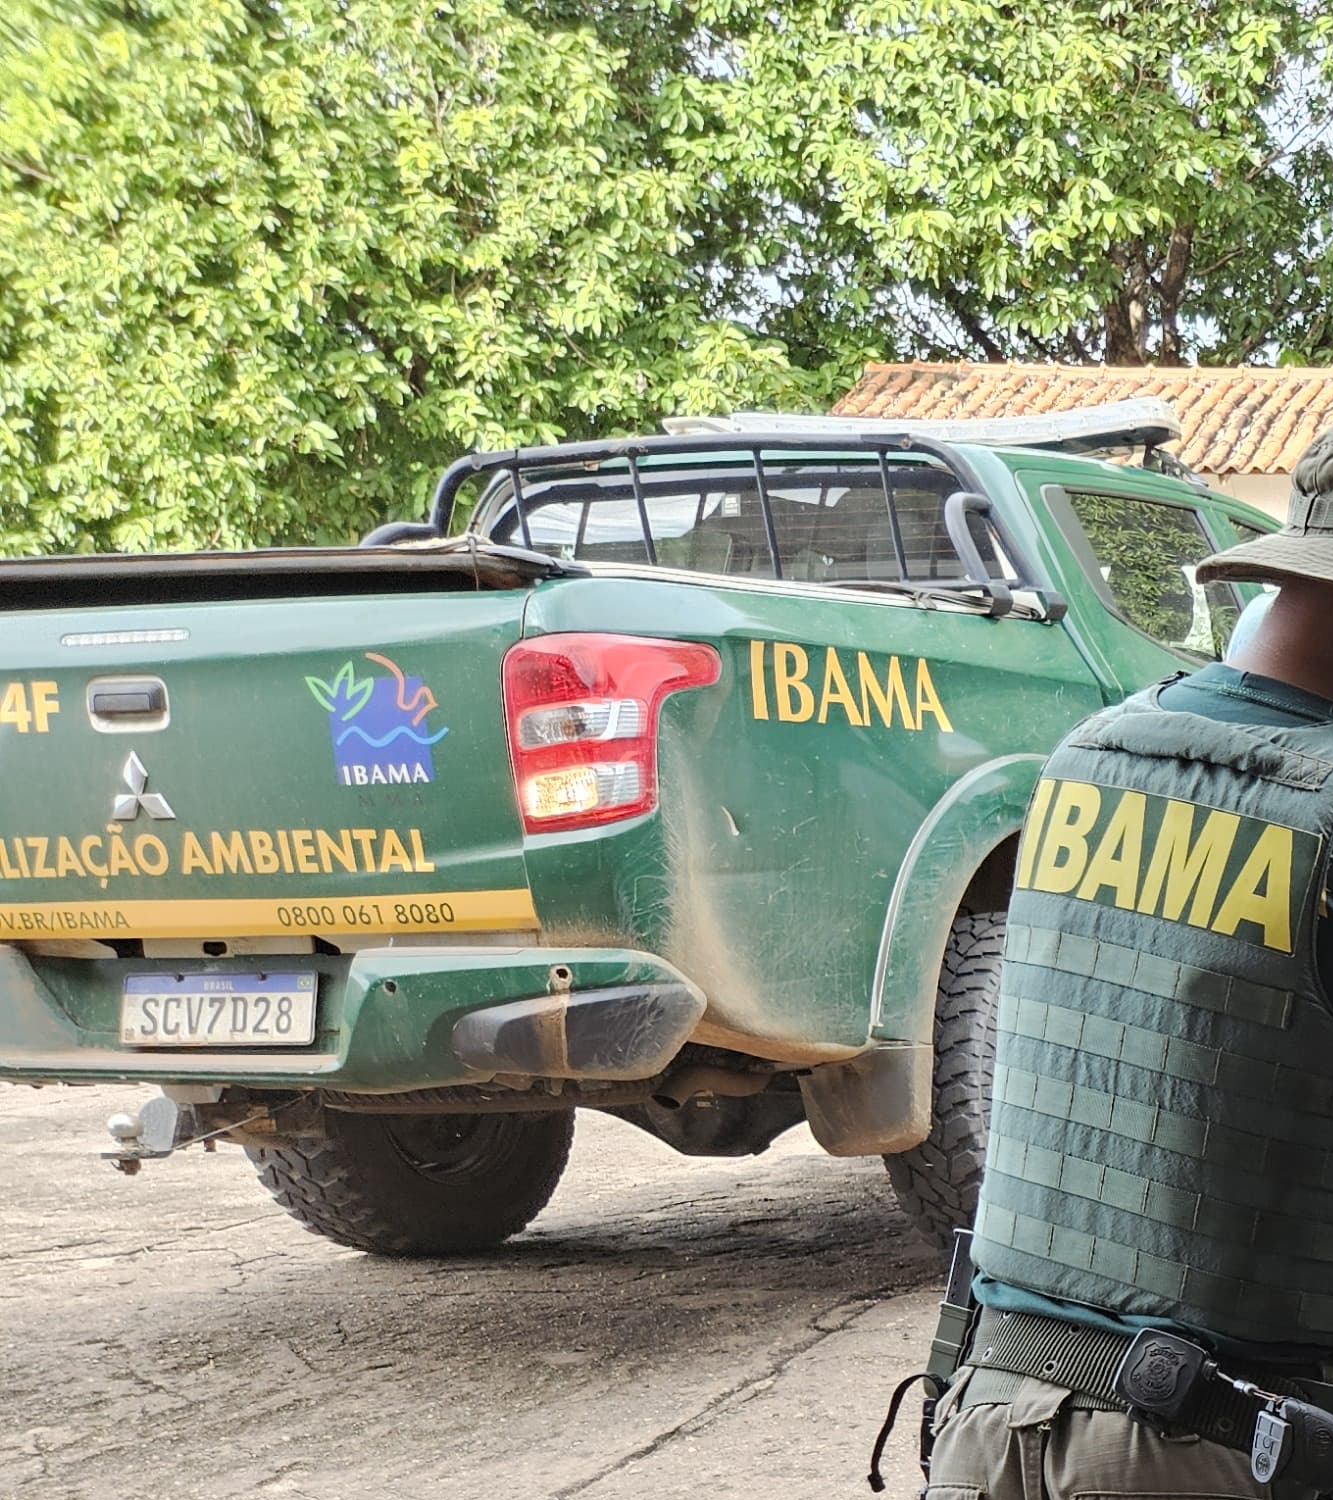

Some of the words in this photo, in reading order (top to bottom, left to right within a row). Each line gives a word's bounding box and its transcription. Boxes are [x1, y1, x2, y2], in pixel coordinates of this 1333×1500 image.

[750, 640, 953, 732] IBAMA
[342, 762, 430, 786] IBAMA
[0, 823, 169, 888] LIZAÇÃO
[181, 827, 436, 876] AMBIENTAL
[1018, 779, 1293, 952] IBAMA
[277, 906, 335, 927] 0800
[342, 904, 384, 926] 061
[394, 902, 454, 924] 8080
[203, 980, 234, 991] BRASIL
[140, 995, 294, 1037] SCV7D28
